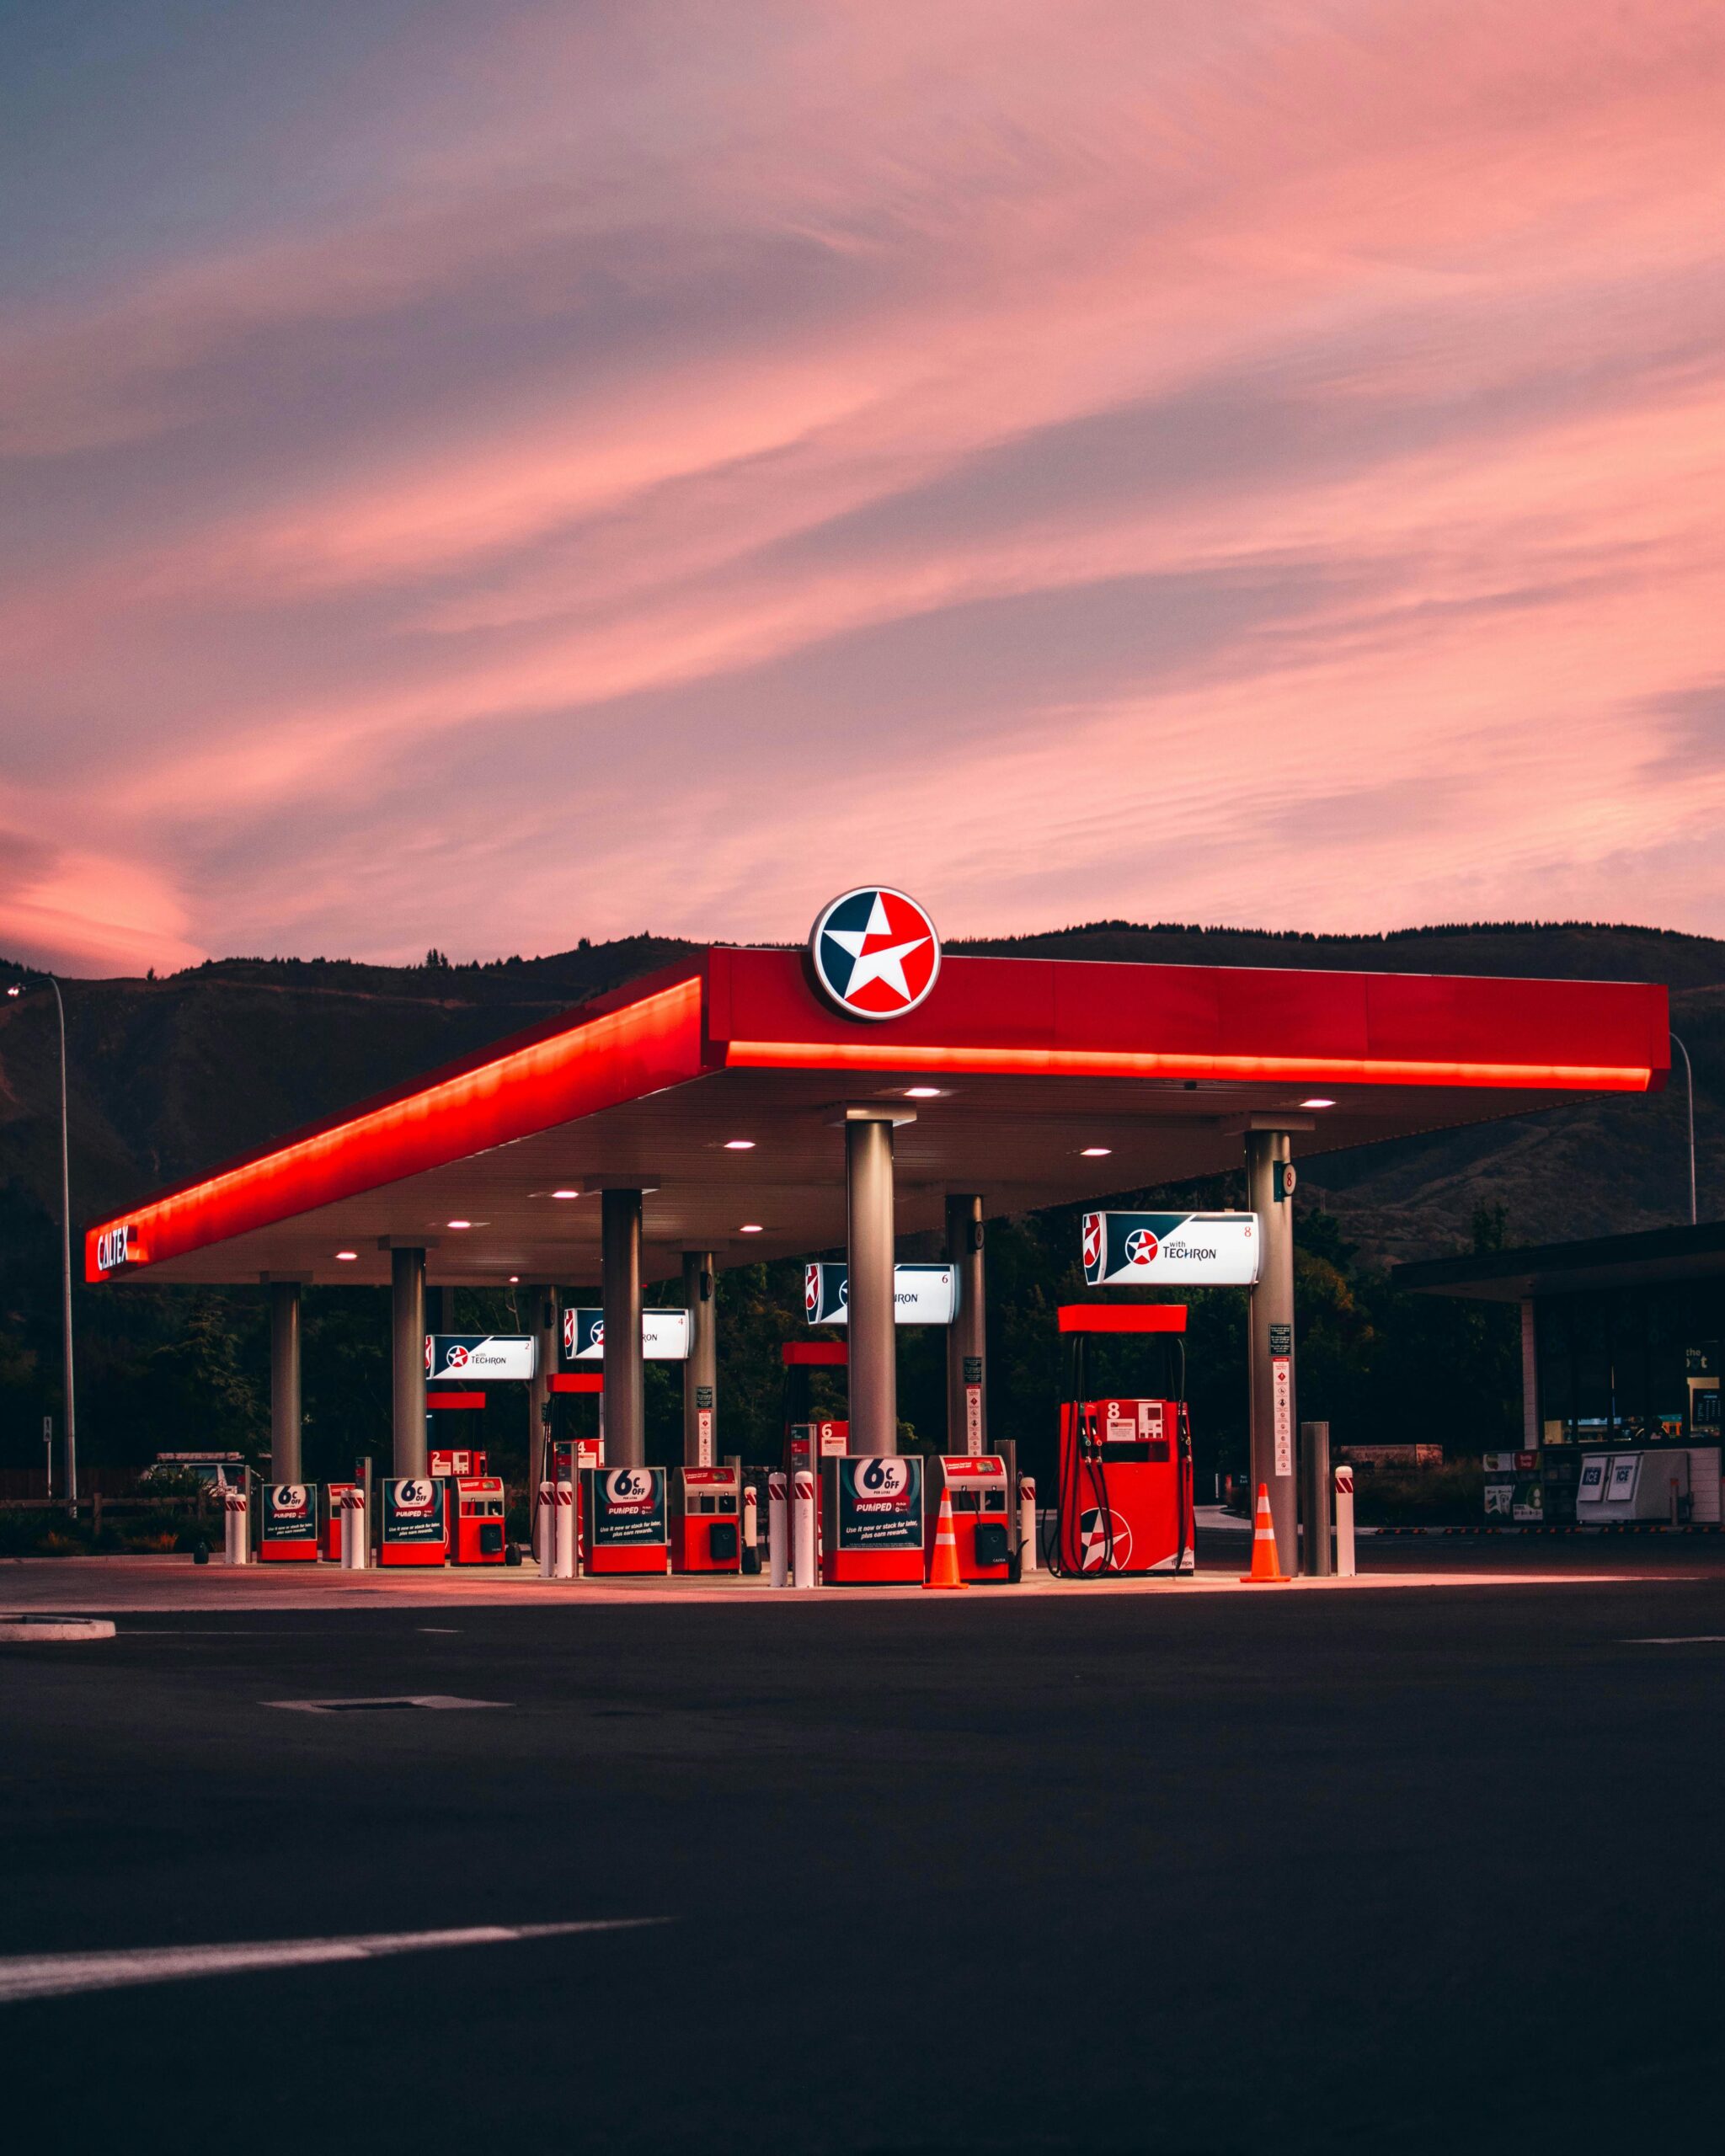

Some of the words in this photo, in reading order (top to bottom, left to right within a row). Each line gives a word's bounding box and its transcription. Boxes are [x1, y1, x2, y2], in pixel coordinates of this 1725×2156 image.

[1287, 1172, 1292, 1187] 8
[1244, 1226, 1252, 1237] 8
[98, 1225, 129, 1271] CALTEX
[1163, 1246, 1216, 1261] TECHRON
[942, 1274, 948, 1283] 6
[472, 1356, 506, 1365] TECHRON
[1108, 1402, 1120, 1419] 8
[822, 1423, 832, 1438] 6
[578, 1442, 585, 1455] 4
[432, 1452, 441, 1462] 2
[1586, 1471, 1598, 1482] ICE
[1616, 1470, 1629, 1482] ICE
[884, 1481, 900, 1489] OFF
[856, 1502, 892, 1513] PUMPED
